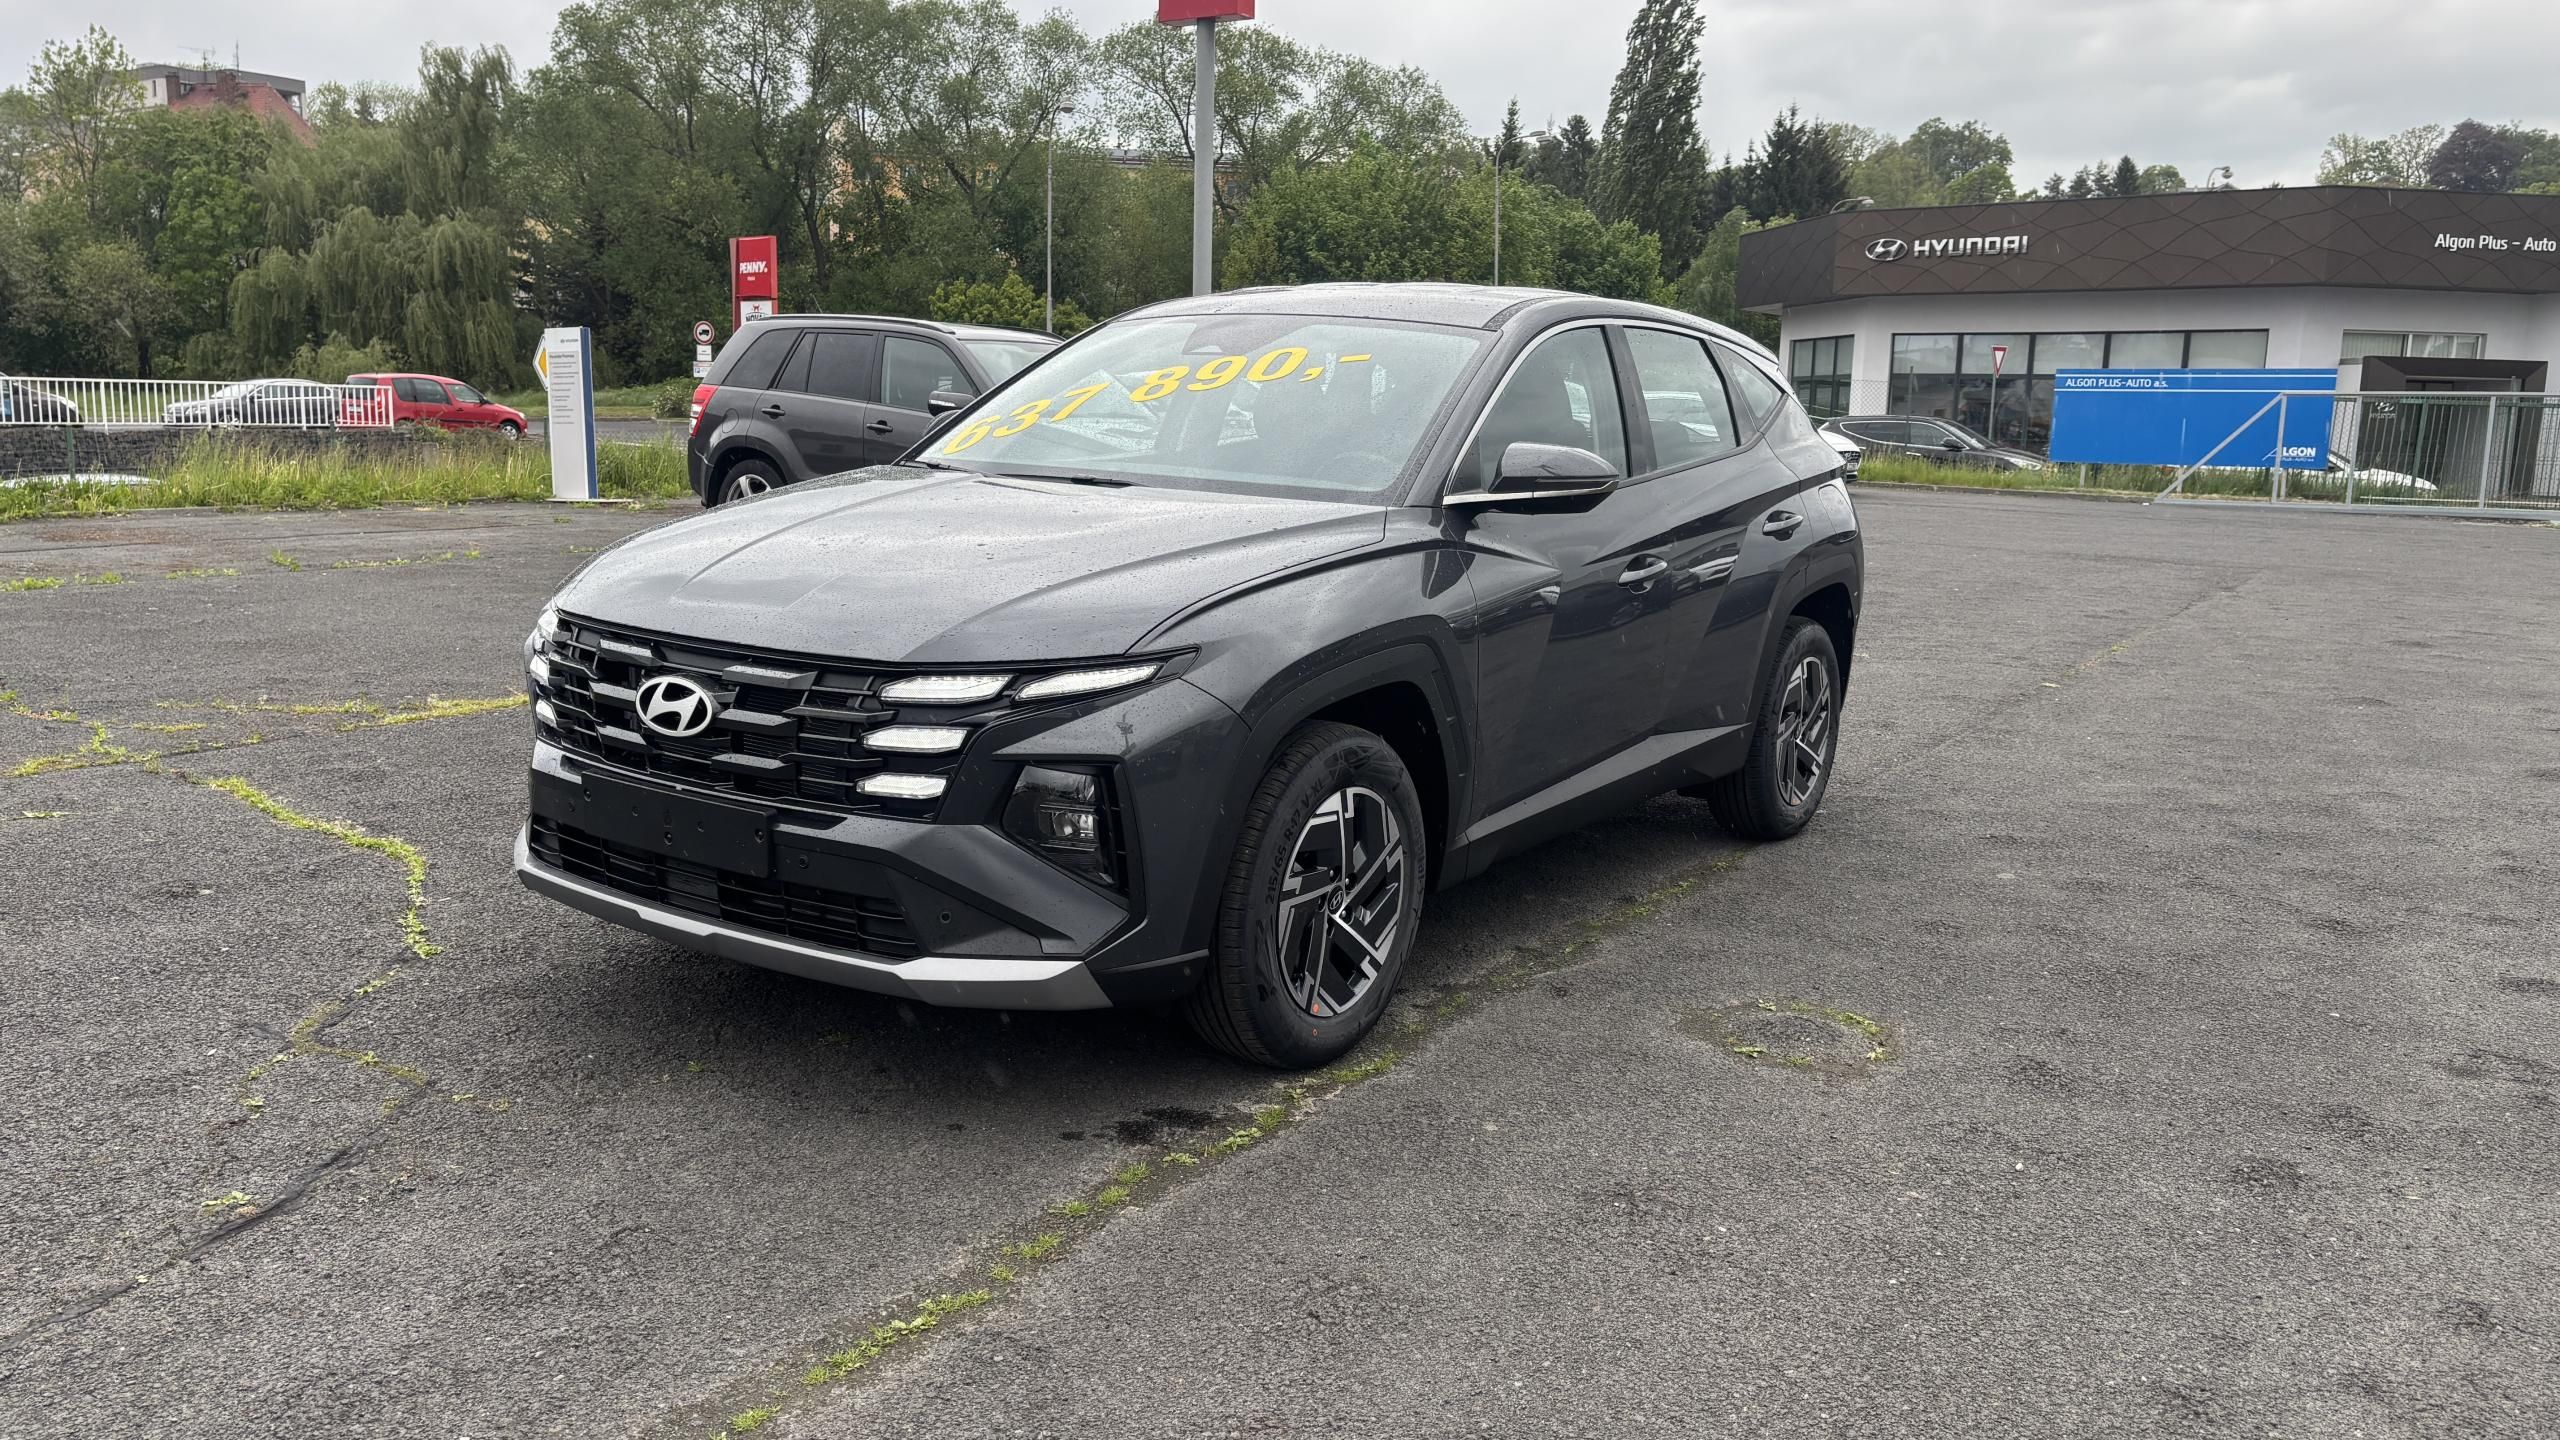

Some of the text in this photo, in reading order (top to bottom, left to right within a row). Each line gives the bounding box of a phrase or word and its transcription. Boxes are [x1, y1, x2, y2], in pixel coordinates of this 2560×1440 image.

[1914, 236, 2028, 257] HYUNDAI
[2434, 234, 2475, 251] Algon
[2478, 236, 2508, 250] Plus
[2523, 237, 2557, 251] Auto
[2065, 378, 2097, 388] ALGON
[2098, 378, 2152, 388] PLUS-AUTO
[943, 382, 1112, 456] 637
